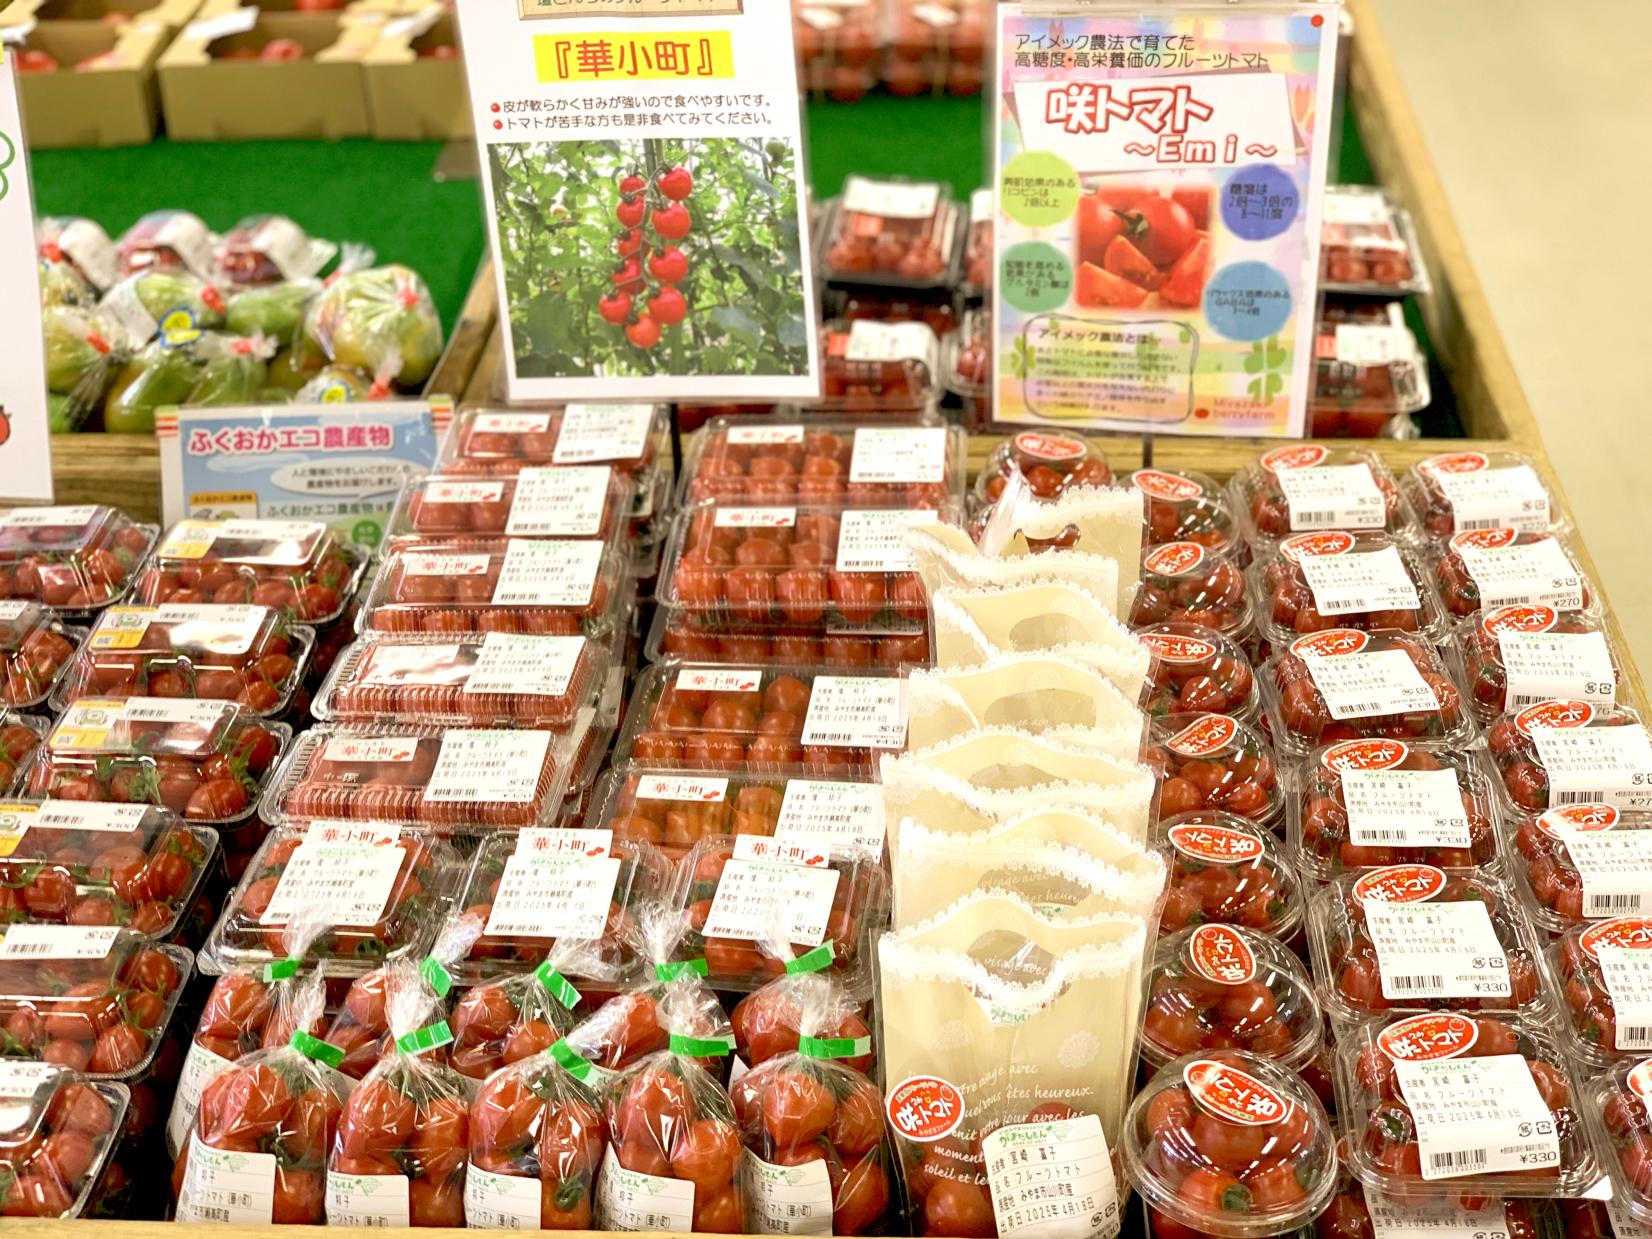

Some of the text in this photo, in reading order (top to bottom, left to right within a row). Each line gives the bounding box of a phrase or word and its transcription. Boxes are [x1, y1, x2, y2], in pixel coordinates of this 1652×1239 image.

[1015, 34, 1195, 51] アイメック農法で育てた
[554, 38, 714, 80] 『華小町』
[1014, 52, 1269, 70] 高糖度・高栄養価のフルーツトマト
[503, 93, 771, 114] 皮が軟らかく甘みが強いので食べやすいです。
[1044, 82, 1214, 135] 咲トマト
[506, 111, 773, 131] トマトが苦手な方も是非食べてみてください。
[189, 425, 392, 452] ふくおかエコ農産物
[1553, 597, 1581, 608] ¥270
[652, 782, 706, 796] 華小町
[320, 828, 379, 843] 華小町
[532, 836, 591, 851] 華小町
[752, 841, 809, 860] 華小町
[1401, 927, 1465, 936] フルーツトマト
[1474, 982, 1509, 993] ¥330
[1387, 1028, 1464, 1058] 咲トマト
[1008, 1062, 1039, 1080] avec
[1034, 1084, 1095, 1099] heureux.
[1437, 1086, 1505, 1099] フルーツトマト
[895, 1096, 954, 1132] 咲トマト
[1002, 1112, 1030, 1128] jour
[1450, 1111, 1485, 1123] 2025年
[1519, 1151, 1558, 1165] ¥330
[924, 1162, 957, 1182] soleil
[957, 1169, 972, 1184] et
[1015, 1162, 1082, 1183] フルーツトマト
[1020, 1183, 1075, 1202] みやま市山川町産
[1026, 1203, 1061, 1222] 2025年
[1062, 1196, 1096, 1215] 4月18日
